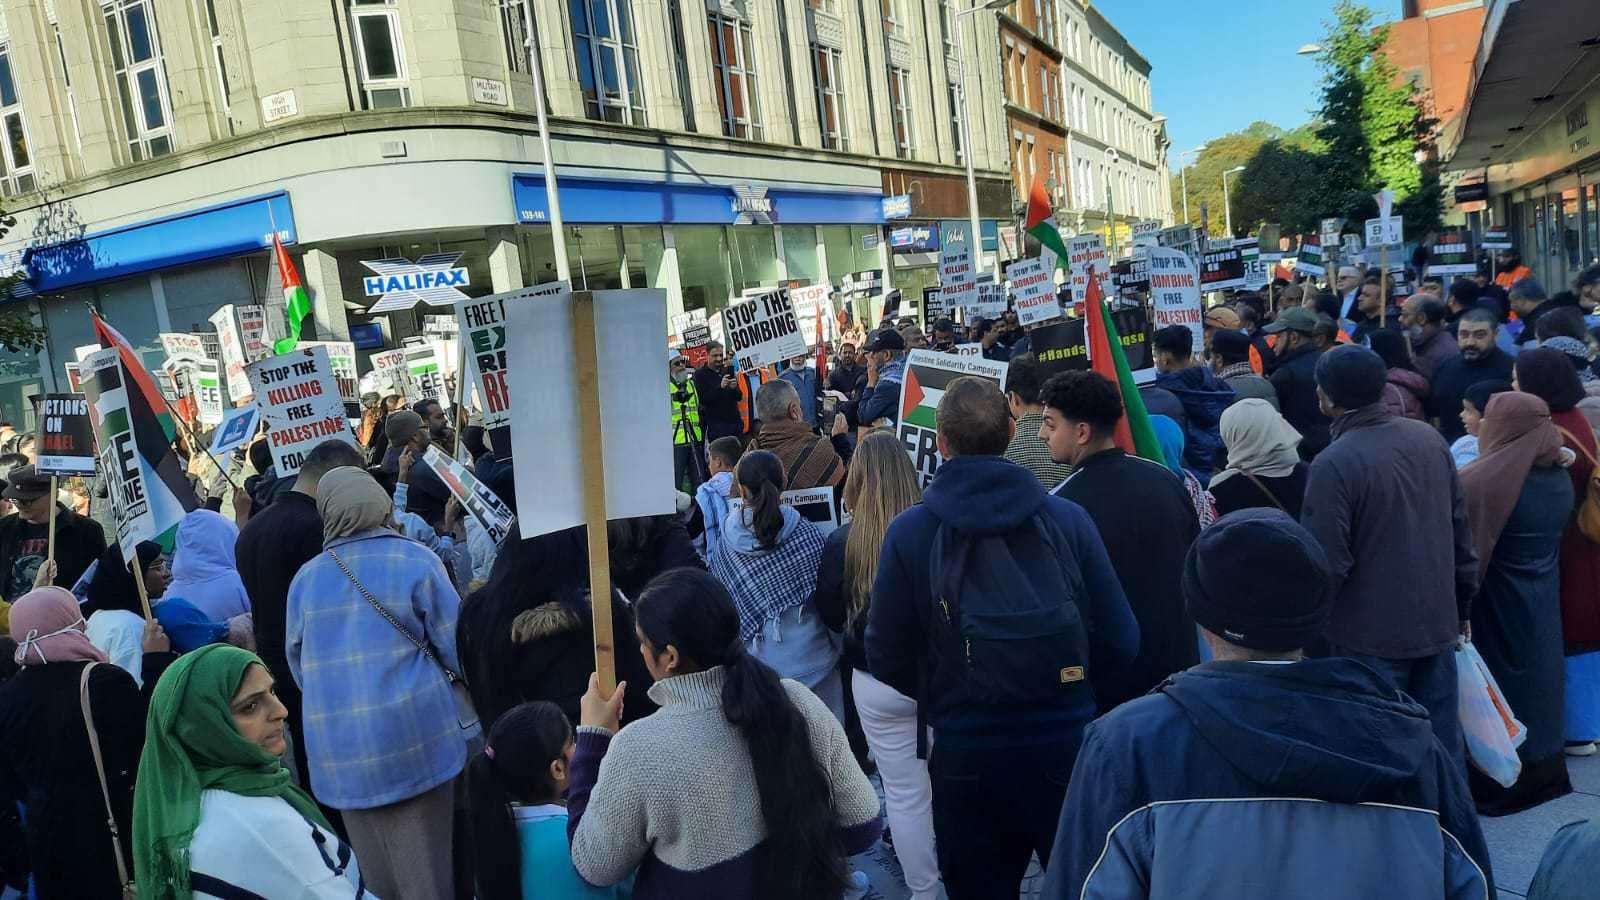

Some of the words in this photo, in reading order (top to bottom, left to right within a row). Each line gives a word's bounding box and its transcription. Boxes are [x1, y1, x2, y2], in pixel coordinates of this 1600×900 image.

[476, 80, 501, 92] MILITARY
[271, 95, 288, 105] HIGH
[482, 91, 498, 101] ROAD
[269, 104, 290, 118] STREET
[1134, 222, 1157, 234] STOP
[1073, 242, 1088, 251] STOP
[1089, 240, 1100, 248] THE
[943, 255, 958, 264] STOP
[959, 253, 968, 261] THE
[1151, 255, 1170, 269] STOP
[1171, 256, 1187, 268] THE
[944, 264, 969, 274] KILLING
[1013, 266, 1028, 277] STOP
[1029, 264, 1041, 273] THE
[366, 269, 466, 294] HALIFAX
[1013, 273, 1048, 288] BOMBING
[792, 288, 824, 302] STOP
[942, 281, 976, 295] PALESTINE
[979, 285, 989, 294] OP
[992, 284, 1006, 293] THE
[978, 293, 1006, 303] MBING
[1017, 293, 1054, 309] PALESTINE
[1163, 292, 1183, 305] FREE
[463, 301, 498, 328] FREE
[726, 300, 757, 330] STOP
[761, 289, 792, 317] THE
[1156, 309, 1201, 324] PALESTINE
[731, 312, 798, 352] BOMBING
[166, 336, 199, 347] STOP
[960, 347, 979, 356] OP
[376, 353, 404, 368] STOP
[936, 358, 966, 371] Solidarity
[968, 362, 1002, 376] Campaign
[260, 366, 290, 384] STOP
[291, 360, 317, 376] THE
[268, 380, 323, 406] KILLING
[287, 404, 314, 420] FREE
[46, 417, 62, 433] ON
[271, 416, 345, 447] PALESTINE
[281, 451, 305, 471] FOA
[794, 493, 829, 504] Campaign
